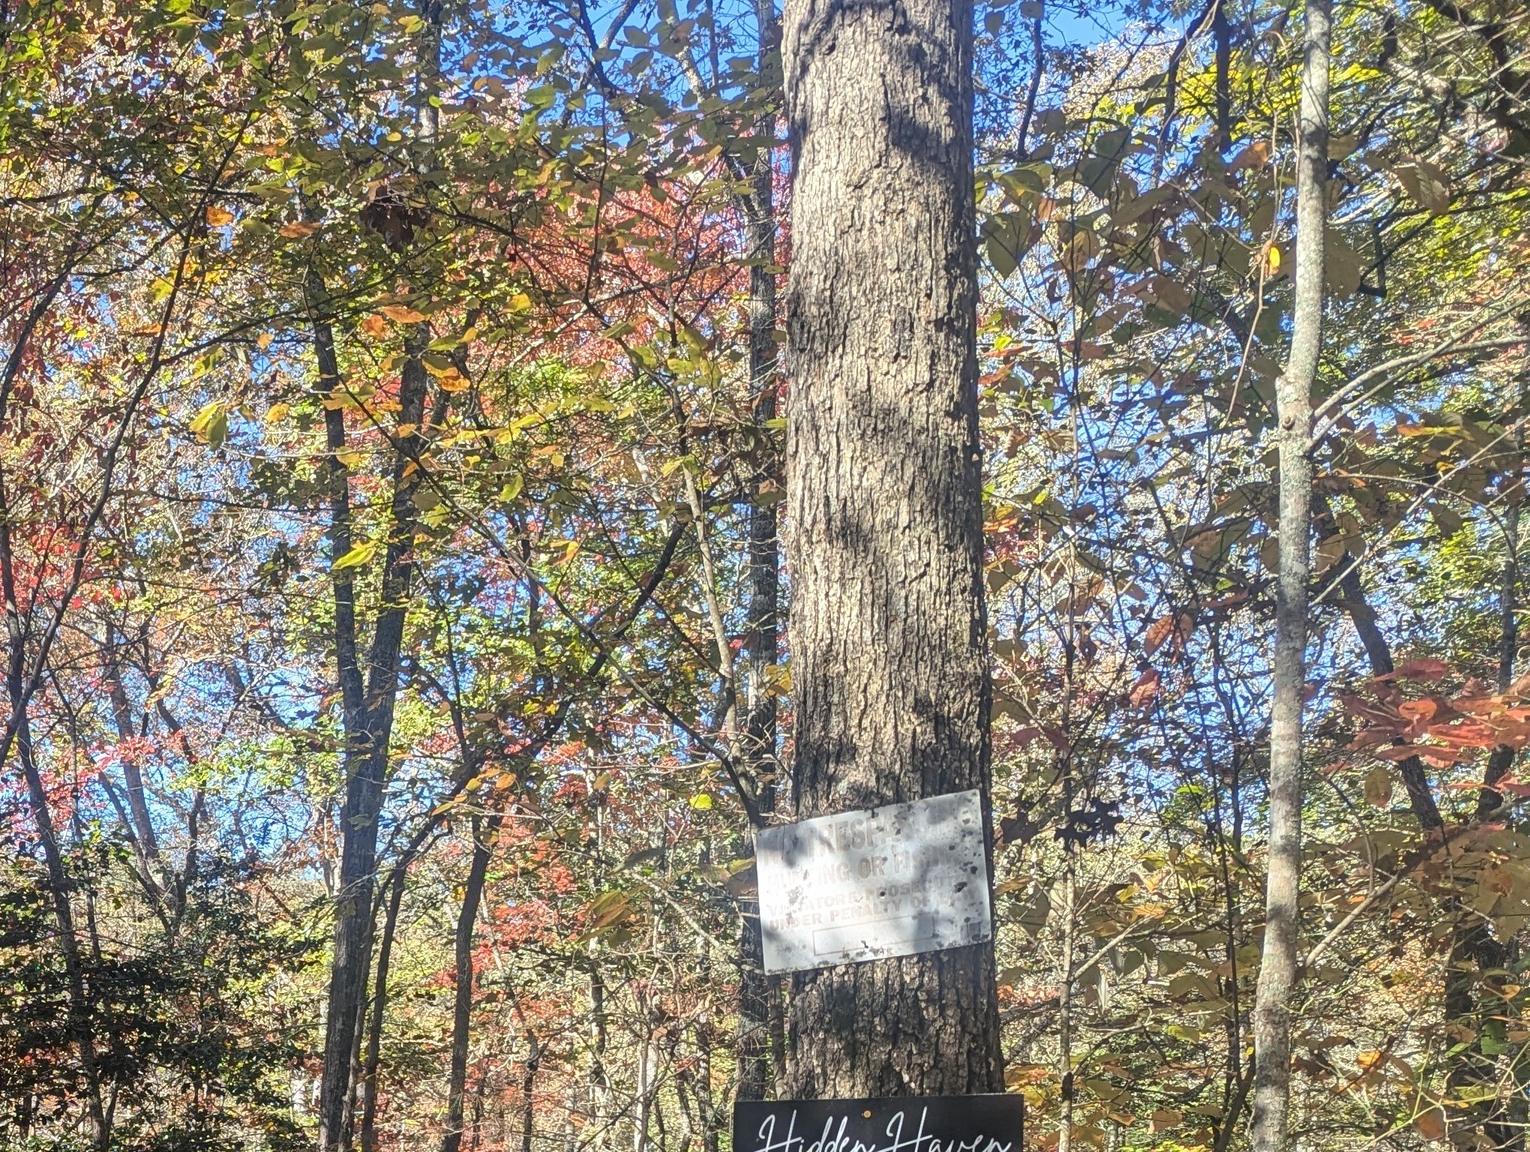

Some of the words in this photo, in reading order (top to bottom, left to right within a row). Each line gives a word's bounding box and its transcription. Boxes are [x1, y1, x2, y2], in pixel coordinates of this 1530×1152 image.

[856, 853, 886, 880] OR
[768, 890, 856, 917] VIATORS
[769, 911, 822, 932] UNDER
[829, 898, 903, 922] PENALTY
[909, 893, 930, 908] OF
